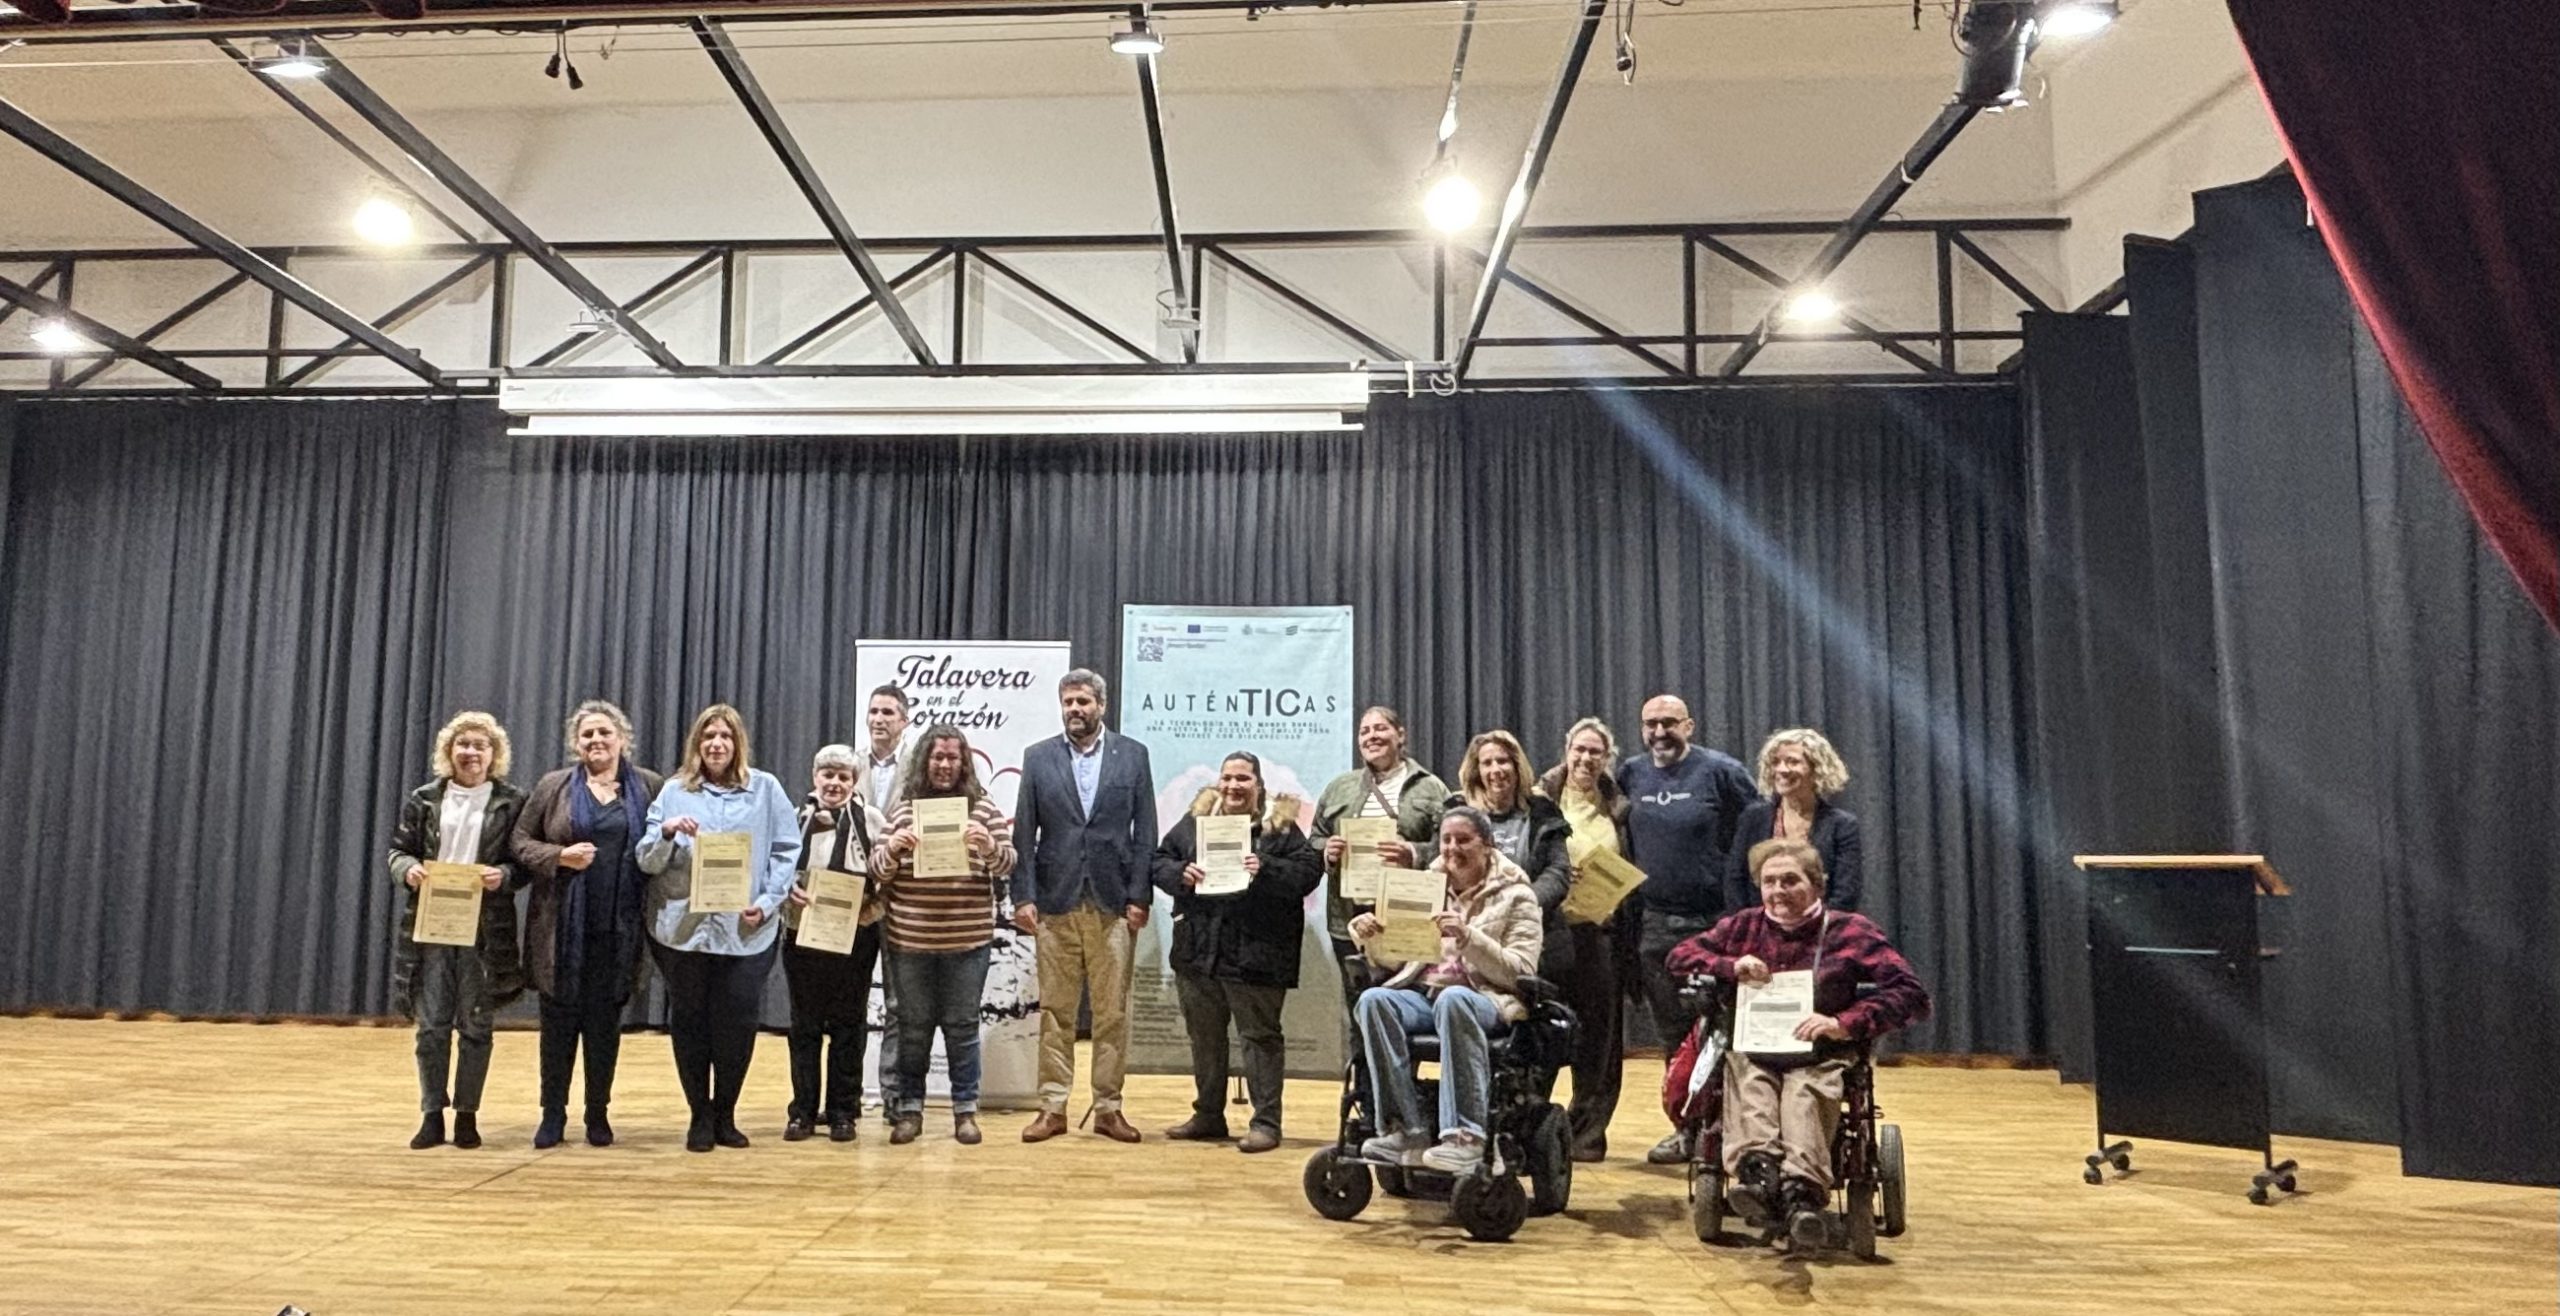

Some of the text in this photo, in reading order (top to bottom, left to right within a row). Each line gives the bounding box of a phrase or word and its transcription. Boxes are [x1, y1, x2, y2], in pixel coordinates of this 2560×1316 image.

[891, 654, 1036, 690] Talavera
[926, 690, 965, 707] en el
[1142, 688, 1336, 717] AUTÉNTICAS
